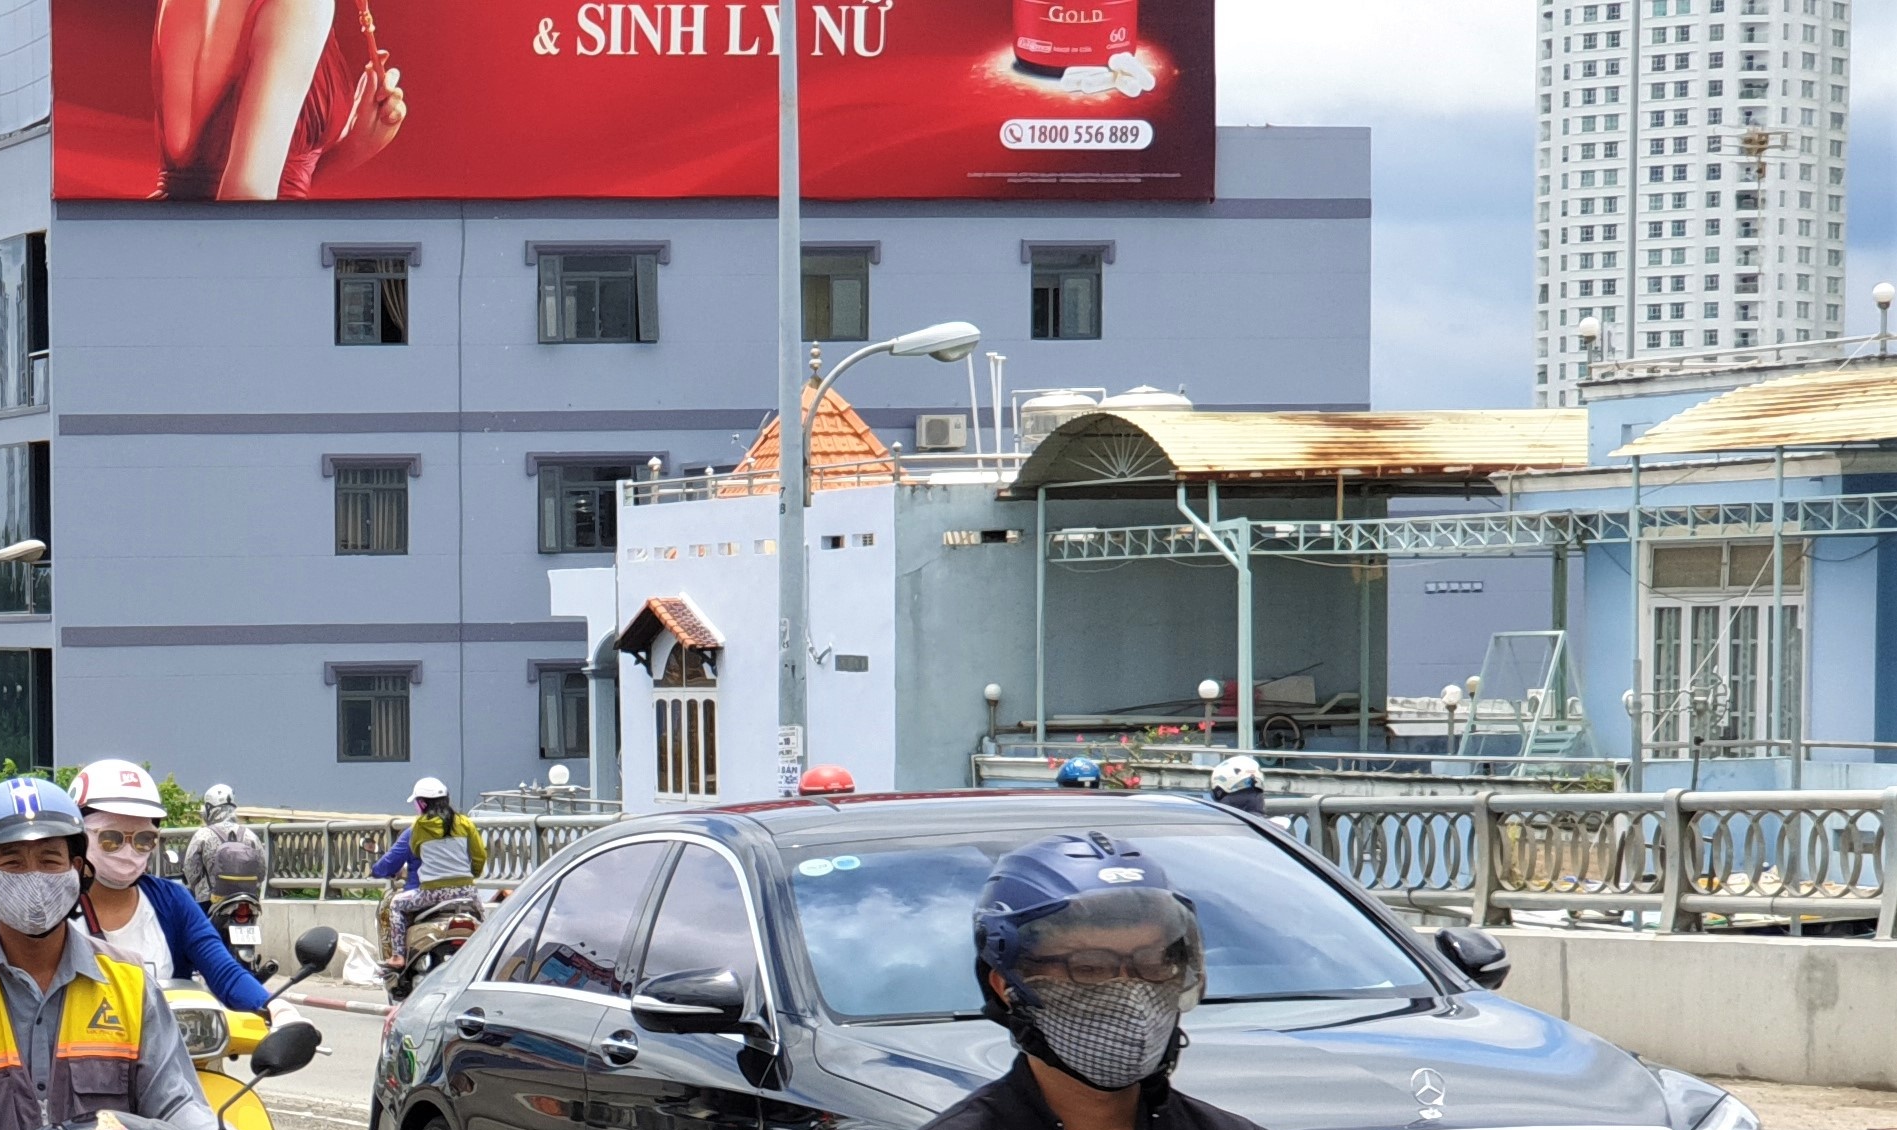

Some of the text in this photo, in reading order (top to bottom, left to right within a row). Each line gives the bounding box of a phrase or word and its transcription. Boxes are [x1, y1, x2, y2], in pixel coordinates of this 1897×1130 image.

[532, 17, 561, 56] &
[576, 3, 709, 57] SINH
[1109, 27, 1127, 43] 60
[1028, 125, 1140, 144] 1800 556 889
